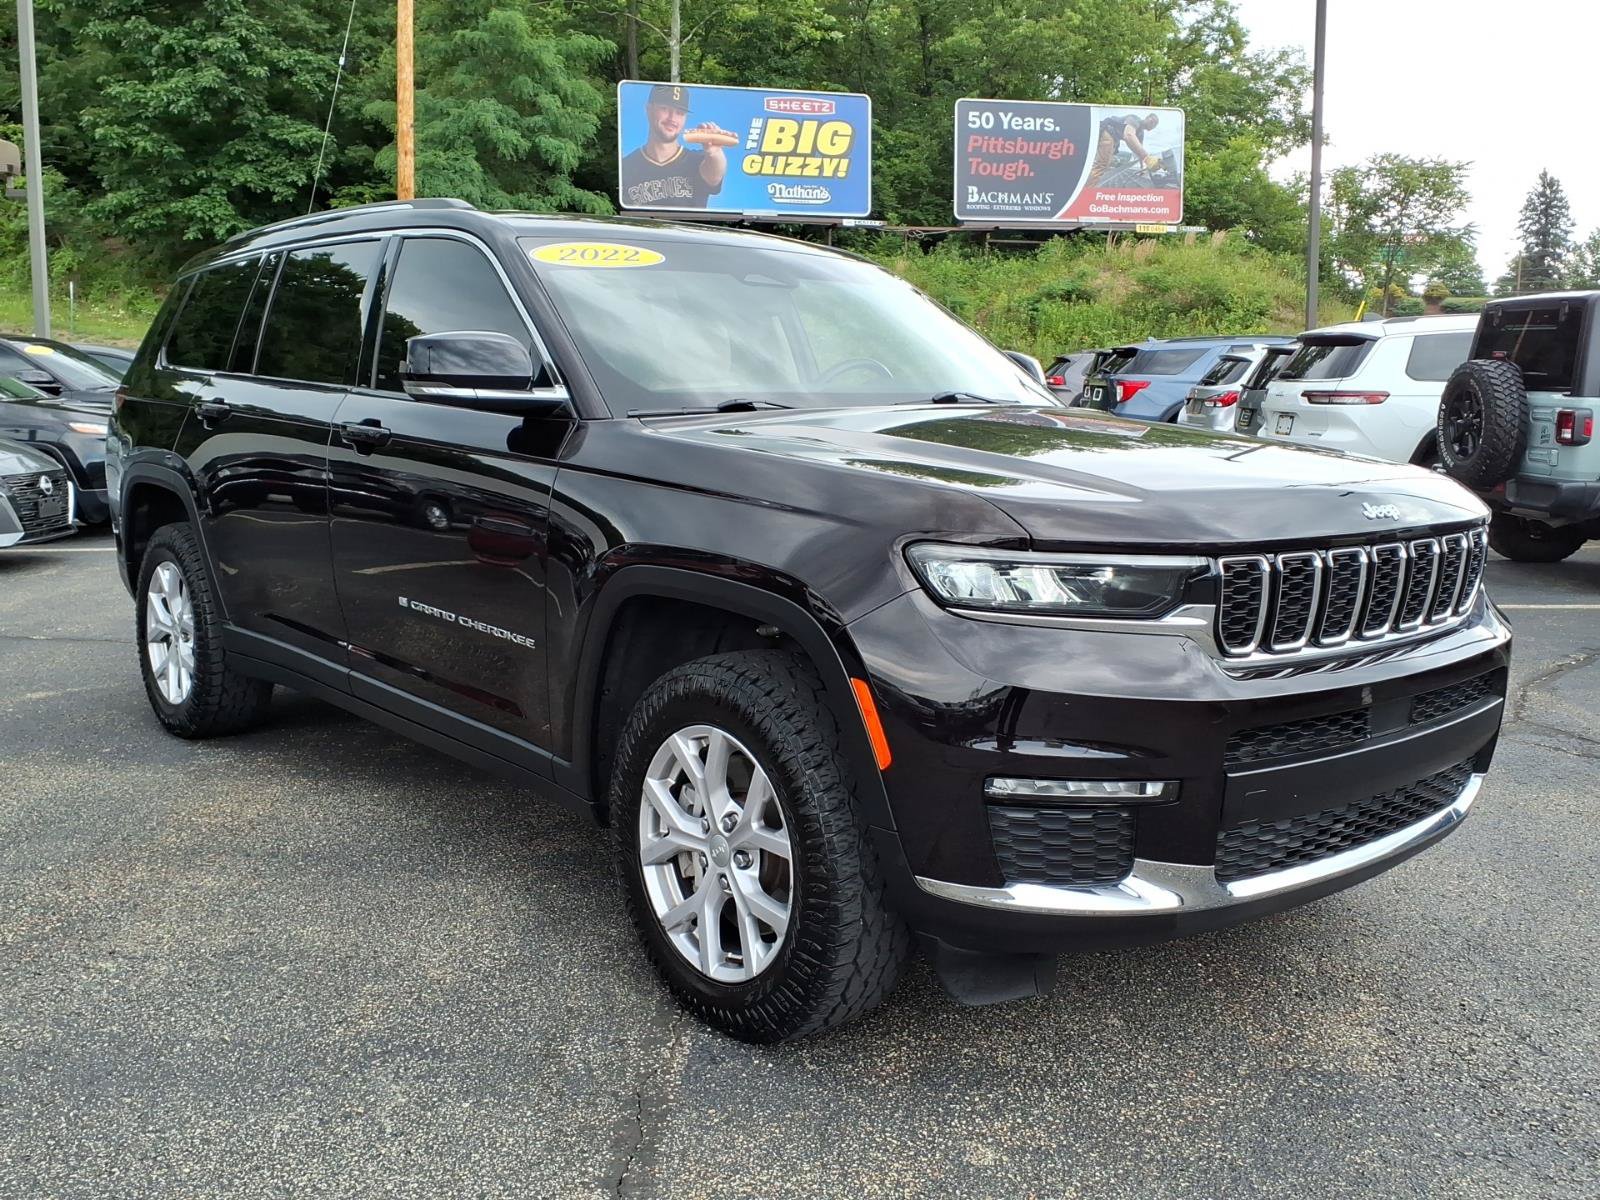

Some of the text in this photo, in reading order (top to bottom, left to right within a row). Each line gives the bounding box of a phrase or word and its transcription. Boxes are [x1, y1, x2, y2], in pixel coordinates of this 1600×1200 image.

[769, 100, 831, 112] SHEETZ
[968, 111, 1061, 132] 50 Years.
[745, 118, 763, 150] THE
[761, 118, 853, 156] BIG
[967, 135, 1075, 160] Pittsburgh
[742, 154, 850, 178] GLIZZY!
[968, 157, 1035, 181] Tough.
[767, 183, 830, 199] Nathan's
[967, 185, 1052, 205] BACHMAN'S
[1096, 192, 1164, 203] Free Inspection
[1089, 204, 1170, 215] GoBachmans.com
[559, 248, 640, 262] 2022
[1361, 502, 1400, 521] Jeep
[410, 600, 536, 649] GRAND CHEROKEE
